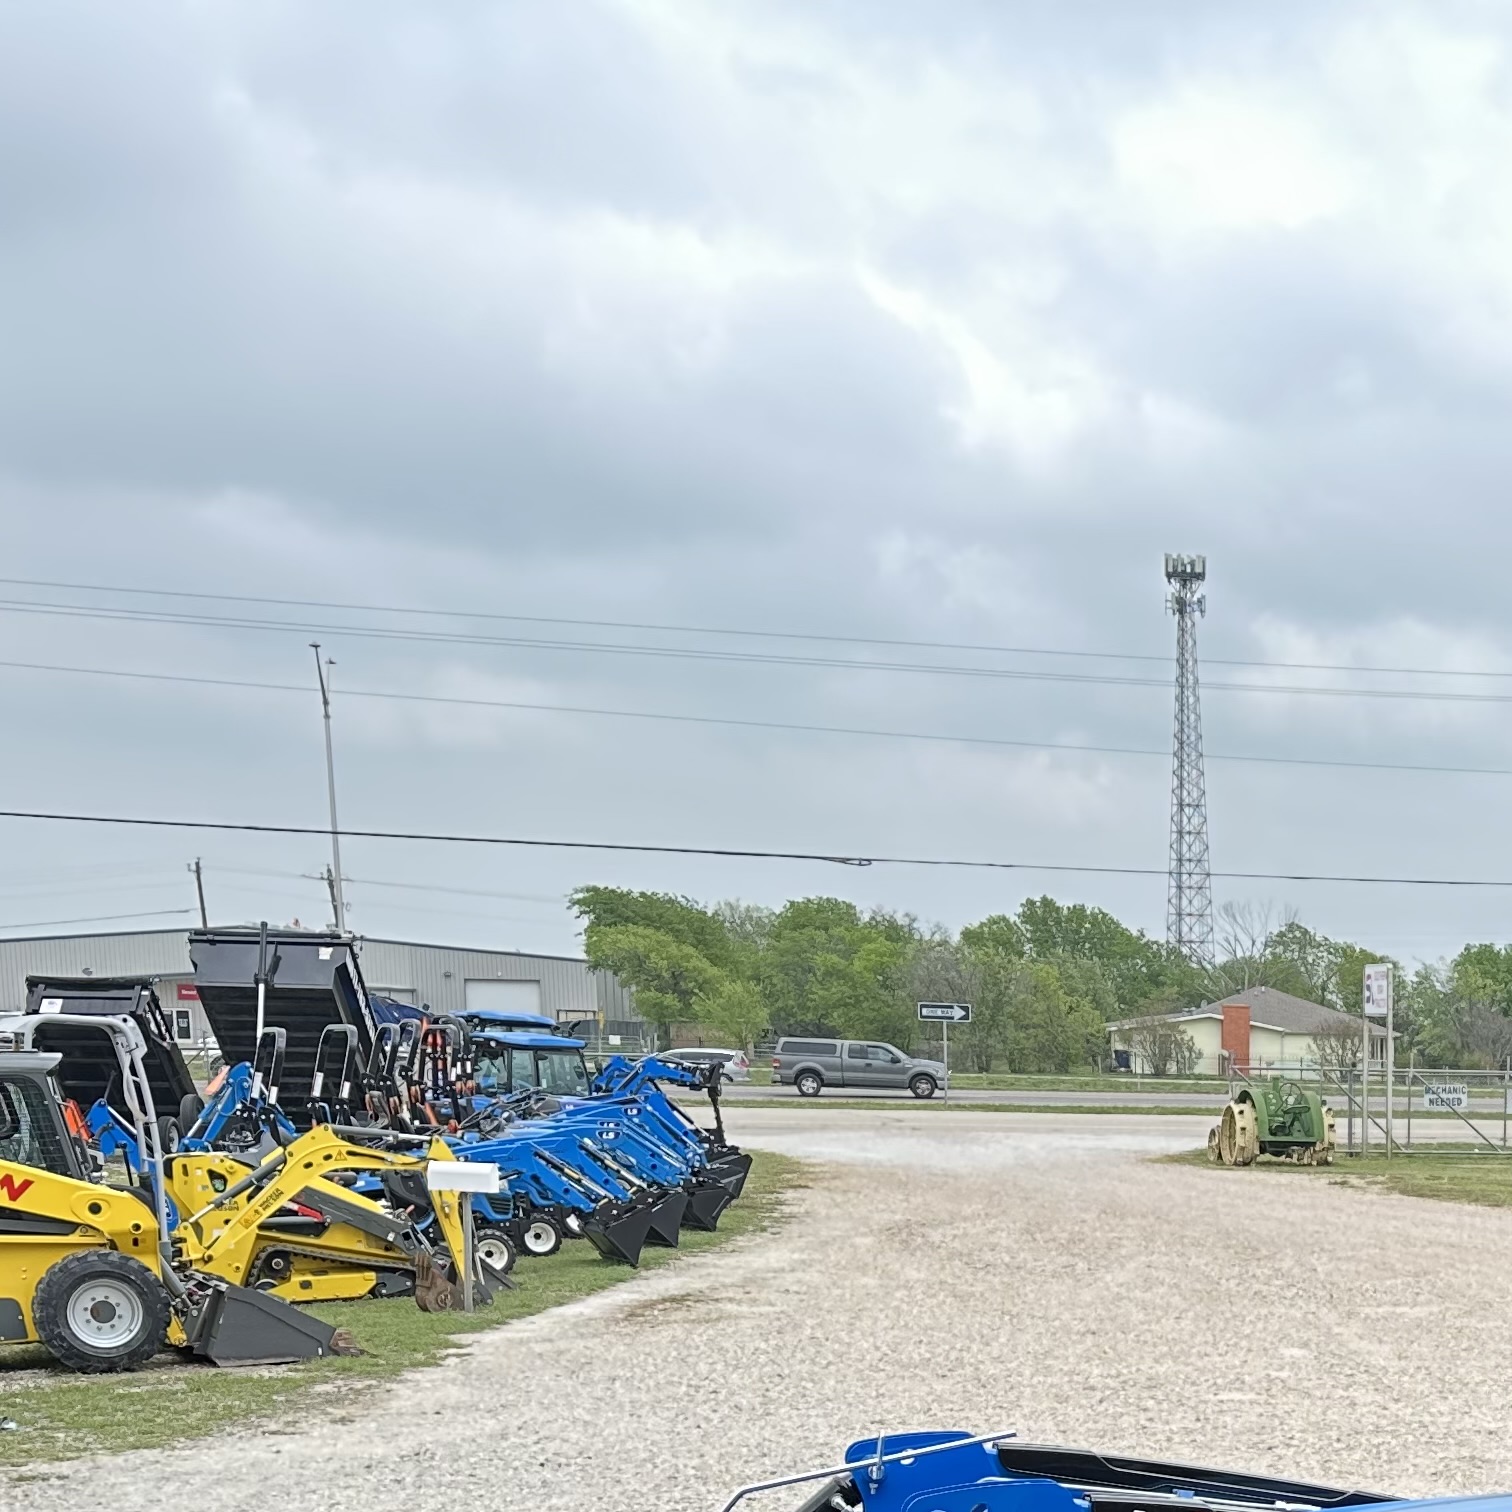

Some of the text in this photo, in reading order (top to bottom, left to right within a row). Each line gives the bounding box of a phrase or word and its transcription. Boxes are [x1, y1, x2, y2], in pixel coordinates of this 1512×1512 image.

[1424, 1085, 1467, 1095] MECHANIC
[1428, 1097, 1463, 1107] NEEDED
[602, 1131, 615, 1139] LS
